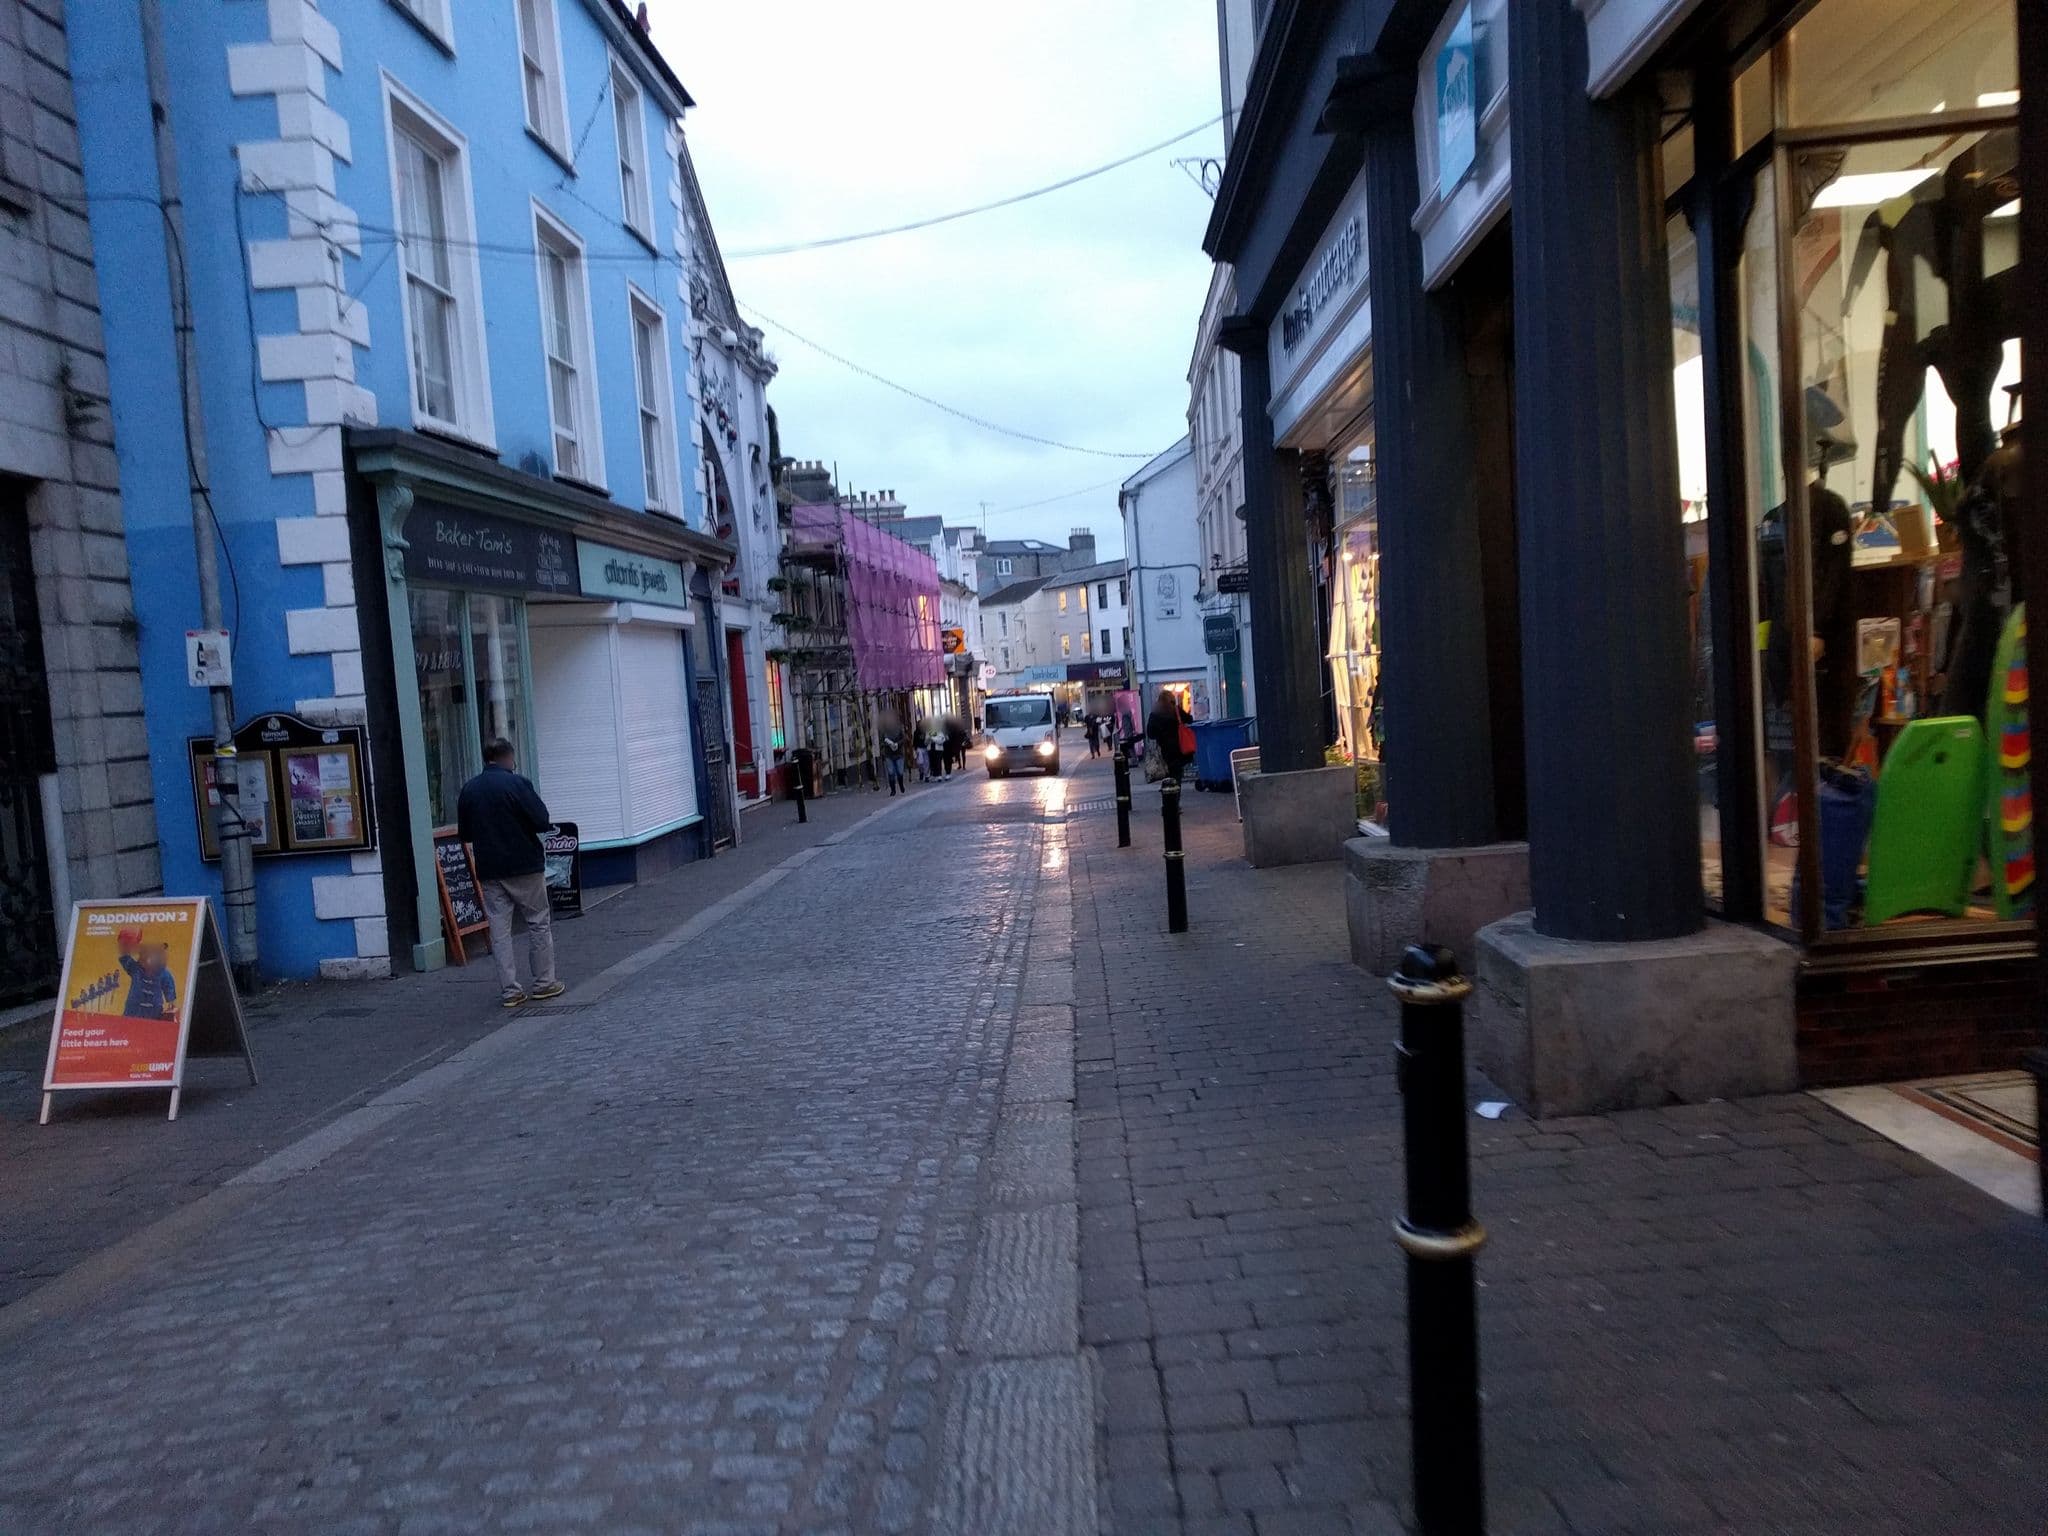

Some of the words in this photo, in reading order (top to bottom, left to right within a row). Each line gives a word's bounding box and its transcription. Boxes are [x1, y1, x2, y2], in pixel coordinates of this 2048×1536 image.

[435, 520, 474, 548] Baker
[476, 528, 513, 555] Tom's
[640, 563, 668, 595] jewels
[1098, 666, 1122, 679] NatWest
[88, 912, 176, 924] PADDINGTON
[178, 911, 188, 922] 2
[63, 1028, 83, 1037] Feed
[85, 1029, 105, 1038] your
[61, 1039, 82, 1048] little
[84, 1038, 108, 1047] bears
[109, 1038, 129, 1047] here
[130, 1062, 171, 1072] SUBWAY
